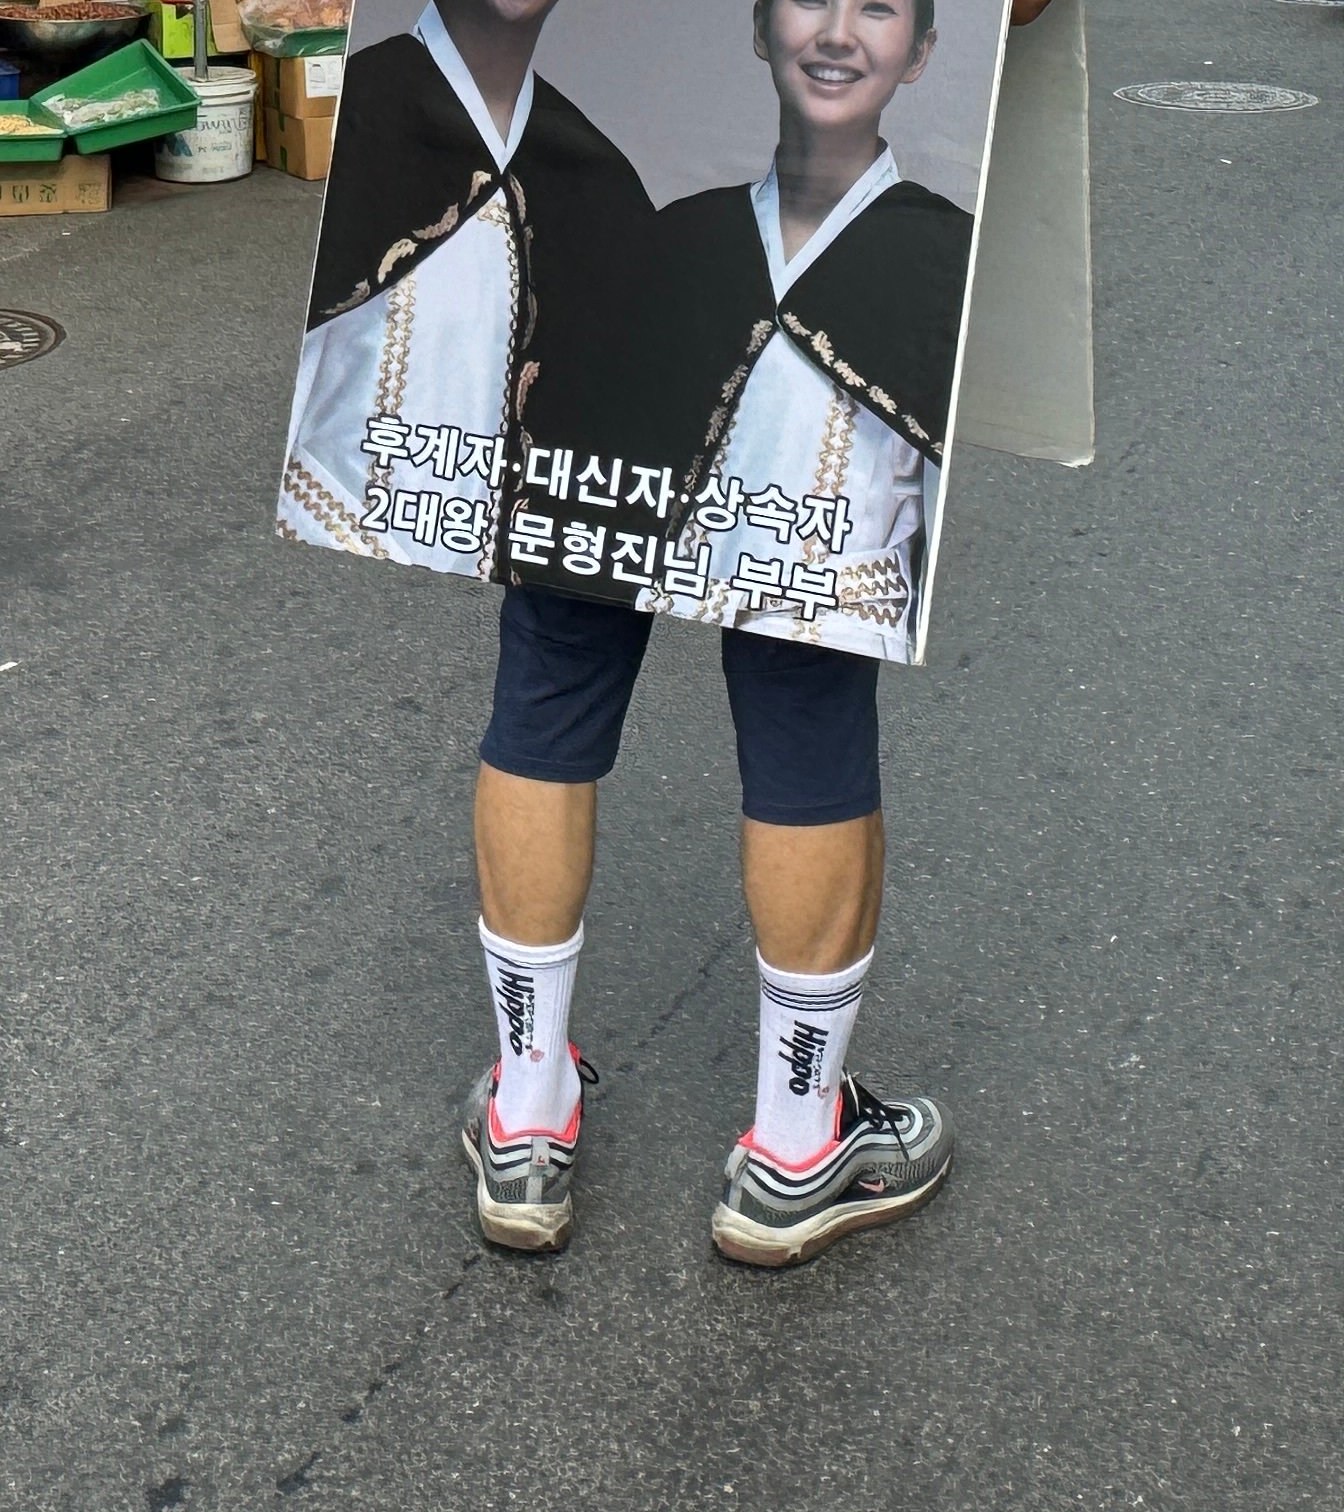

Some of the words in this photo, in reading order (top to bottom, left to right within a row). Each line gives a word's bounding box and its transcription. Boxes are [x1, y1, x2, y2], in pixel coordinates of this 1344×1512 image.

[360, 484, 490, 556] 2대왕
[507, 510, 714, 601] 문형진님
[730, 553, 840, 623] 부부
[495, 966, 535, 1057] Hippo
[777, 1019, 830, 1097] Hippo
